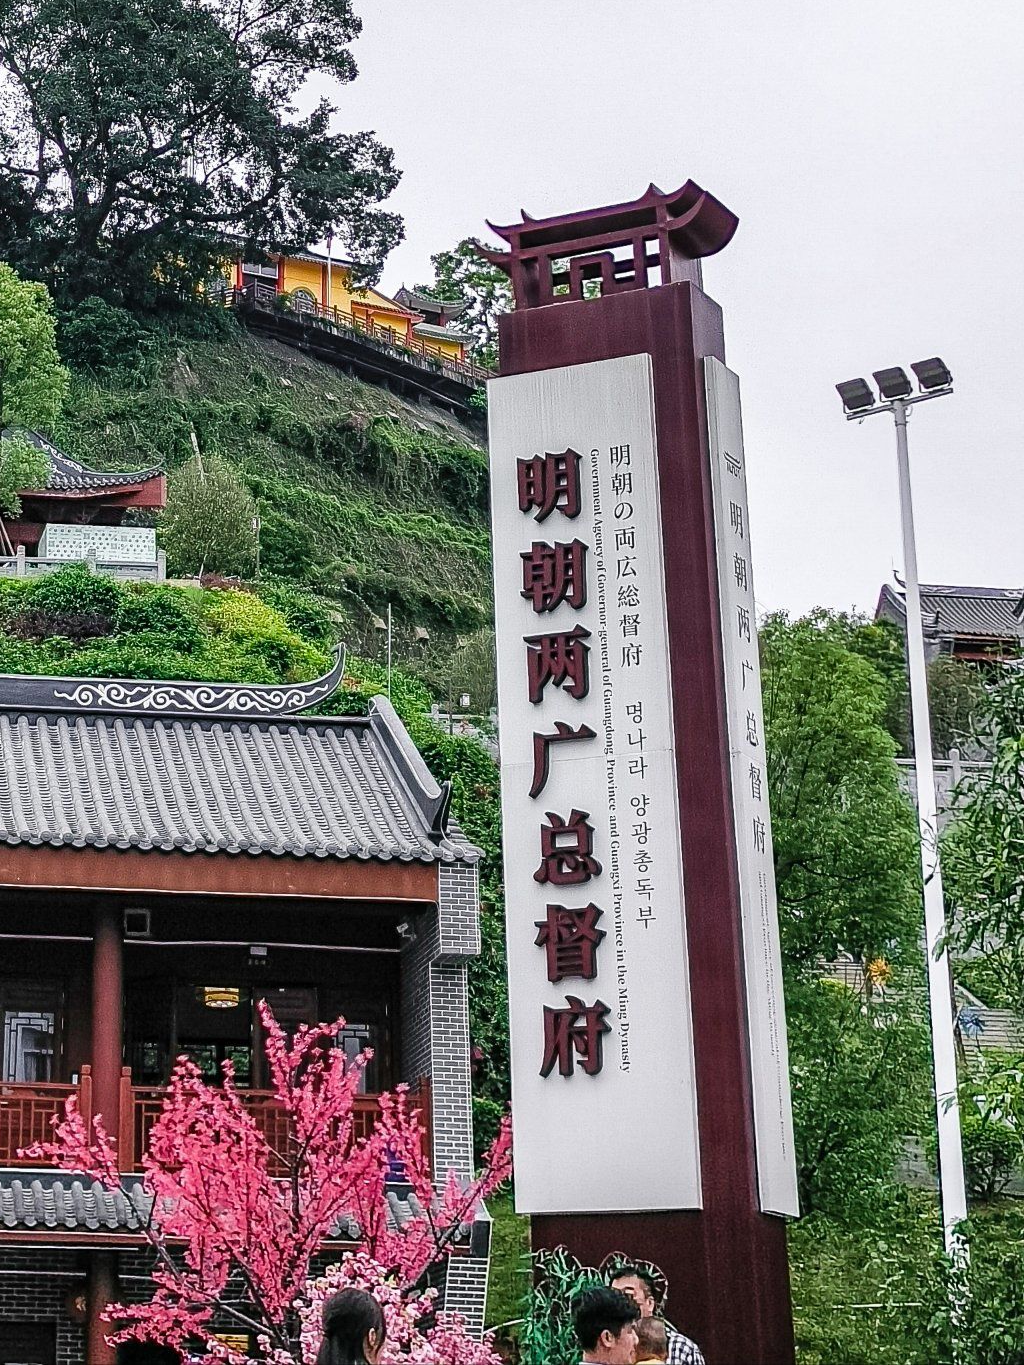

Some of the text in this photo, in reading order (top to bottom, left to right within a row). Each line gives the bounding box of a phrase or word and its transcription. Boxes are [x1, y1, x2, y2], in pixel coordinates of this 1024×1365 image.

[609, 443, 643, 668] 明朝の両広総督府
[729, 500, 766, 855] 明朝两广总督府
[516, 447, 613, 1078] 明朝两广总督府
[590, 448, 631, 1074] Government Agency of Governor-general of Guangdong Province and Guangxi Province in the Ming Dynasty
[625, 701, 657, 930] 명나라 양광총독부
